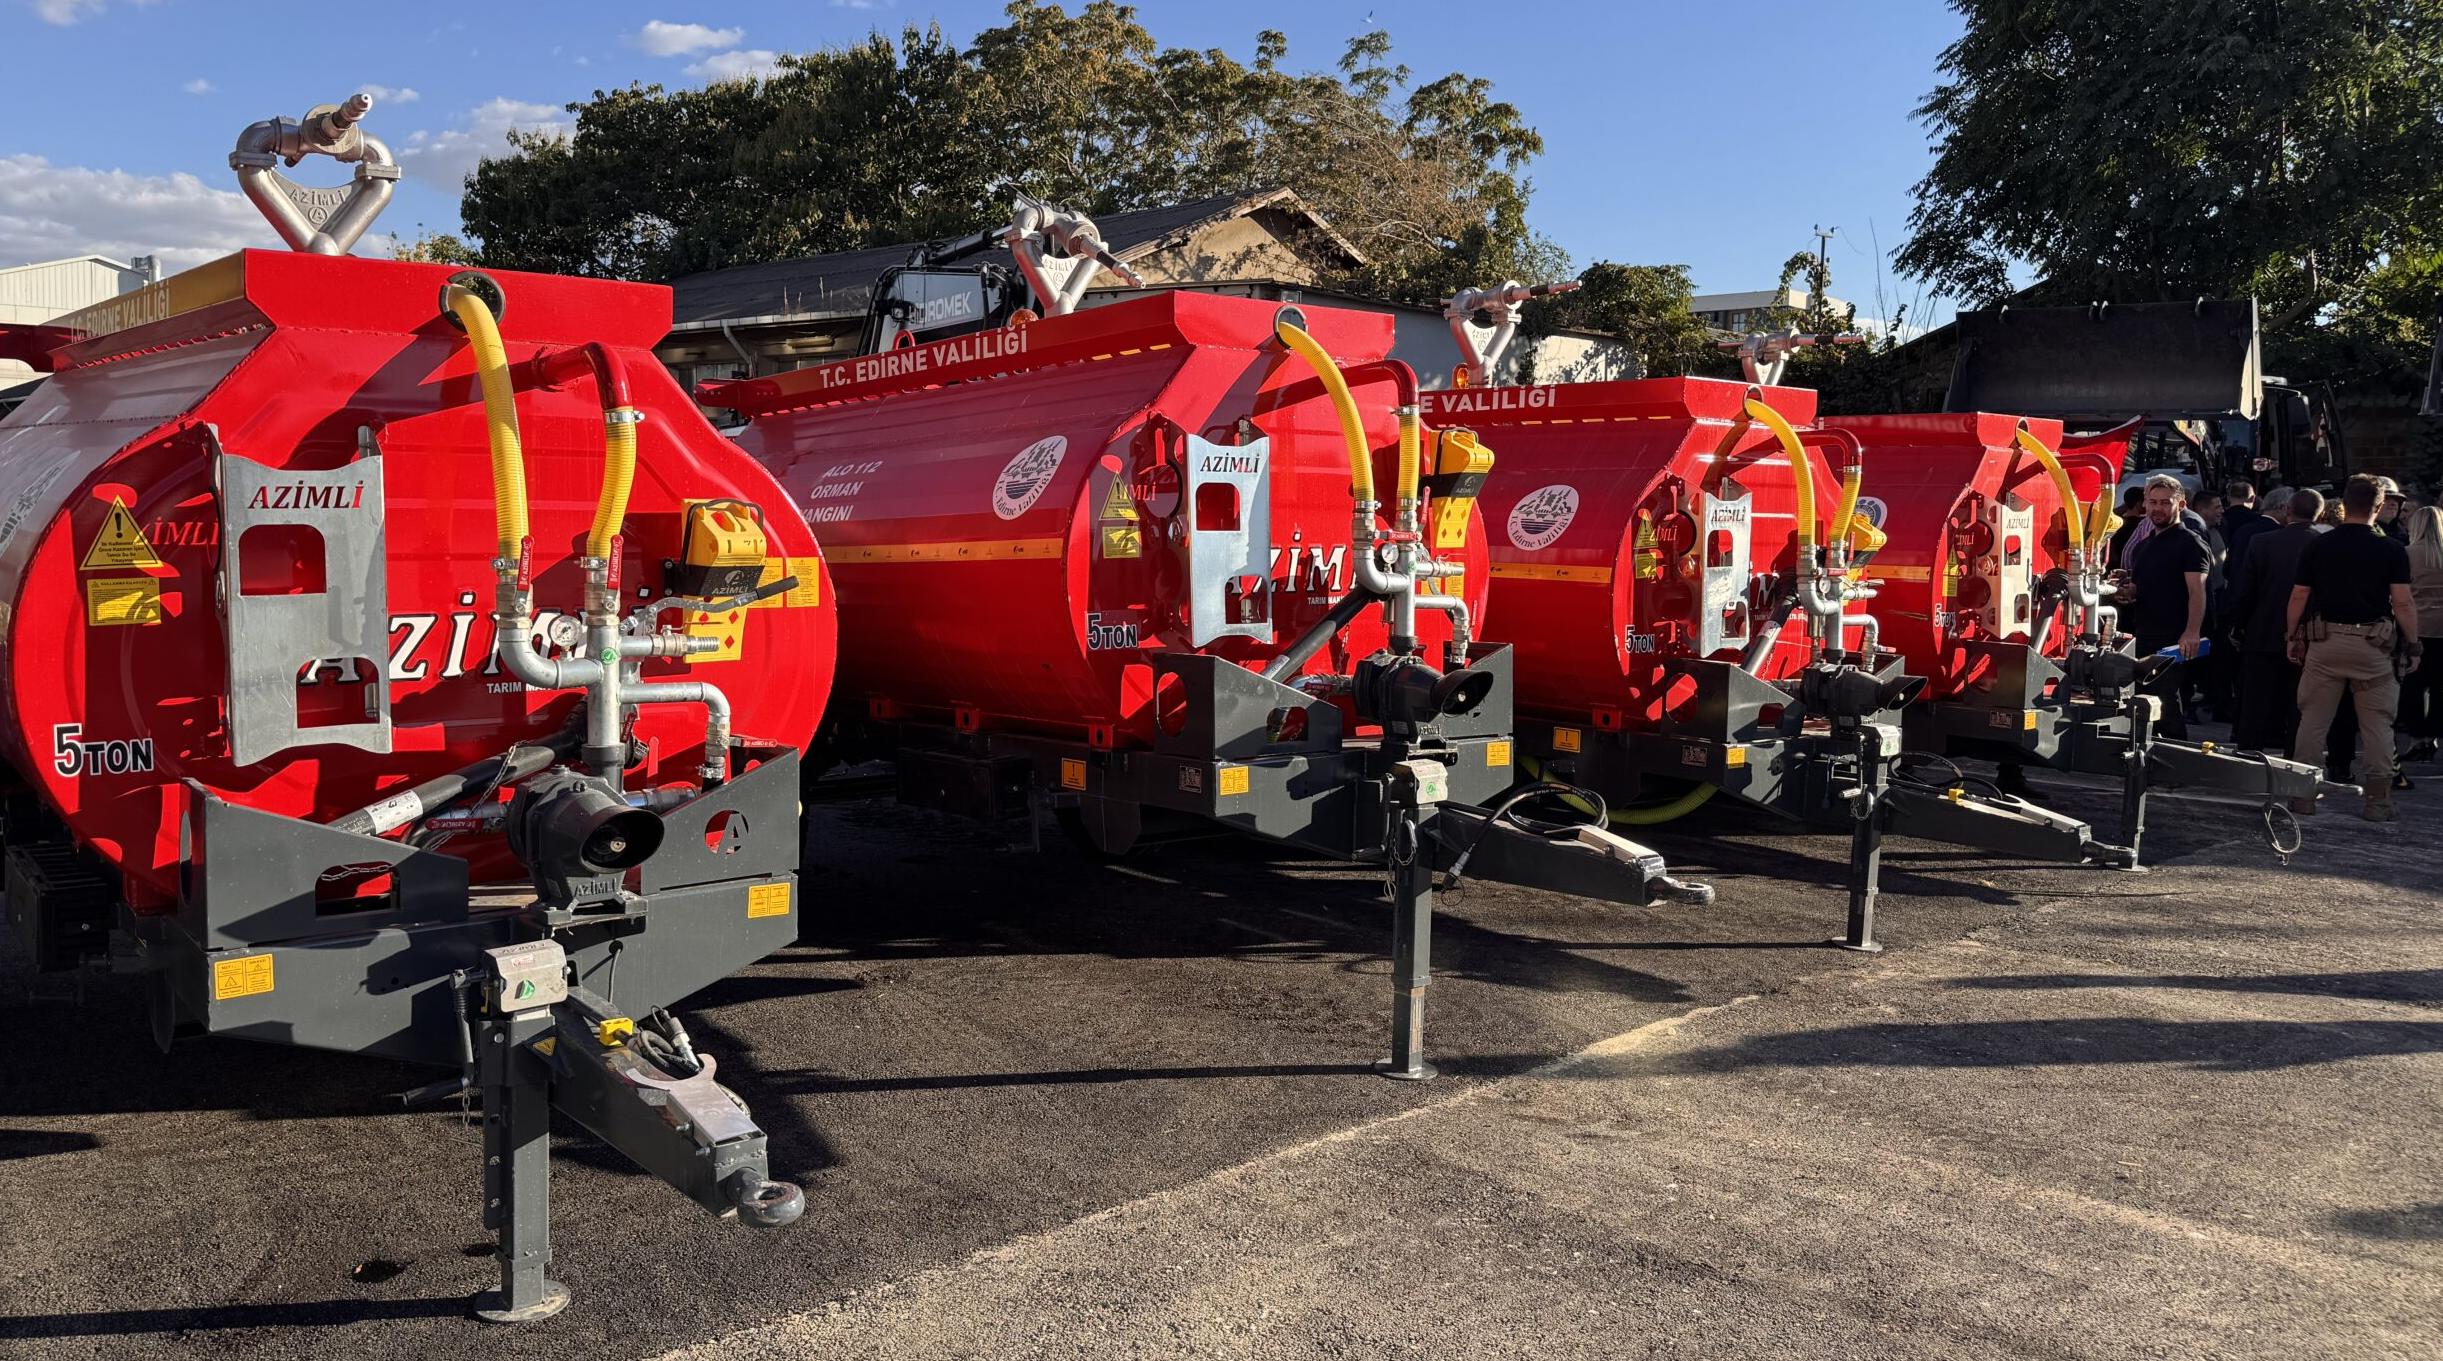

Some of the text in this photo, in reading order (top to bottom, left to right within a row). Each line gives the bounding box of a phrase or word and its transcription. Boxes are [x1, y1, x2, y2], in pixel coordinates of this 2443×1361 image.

[820, 324, 1028, 389] T.C. EDİRNE VALİLİĞİ
[1441, 384, 1556, 413] VALİLİĞİ
[822, 461, 883, 478] ALO 112
[1200, 453, 1261, 473] AZİMLİ
[248, 480, 365, 509] AZİMLİ
[810, 481, 864, 500] ORMAN
[1308, 596, 1326, 605] TARIM
[1087, 612, 1137, 650] 5TON
[487, 681, 522, 694] TARIM
[53, 723, 154, 777] 5TON
